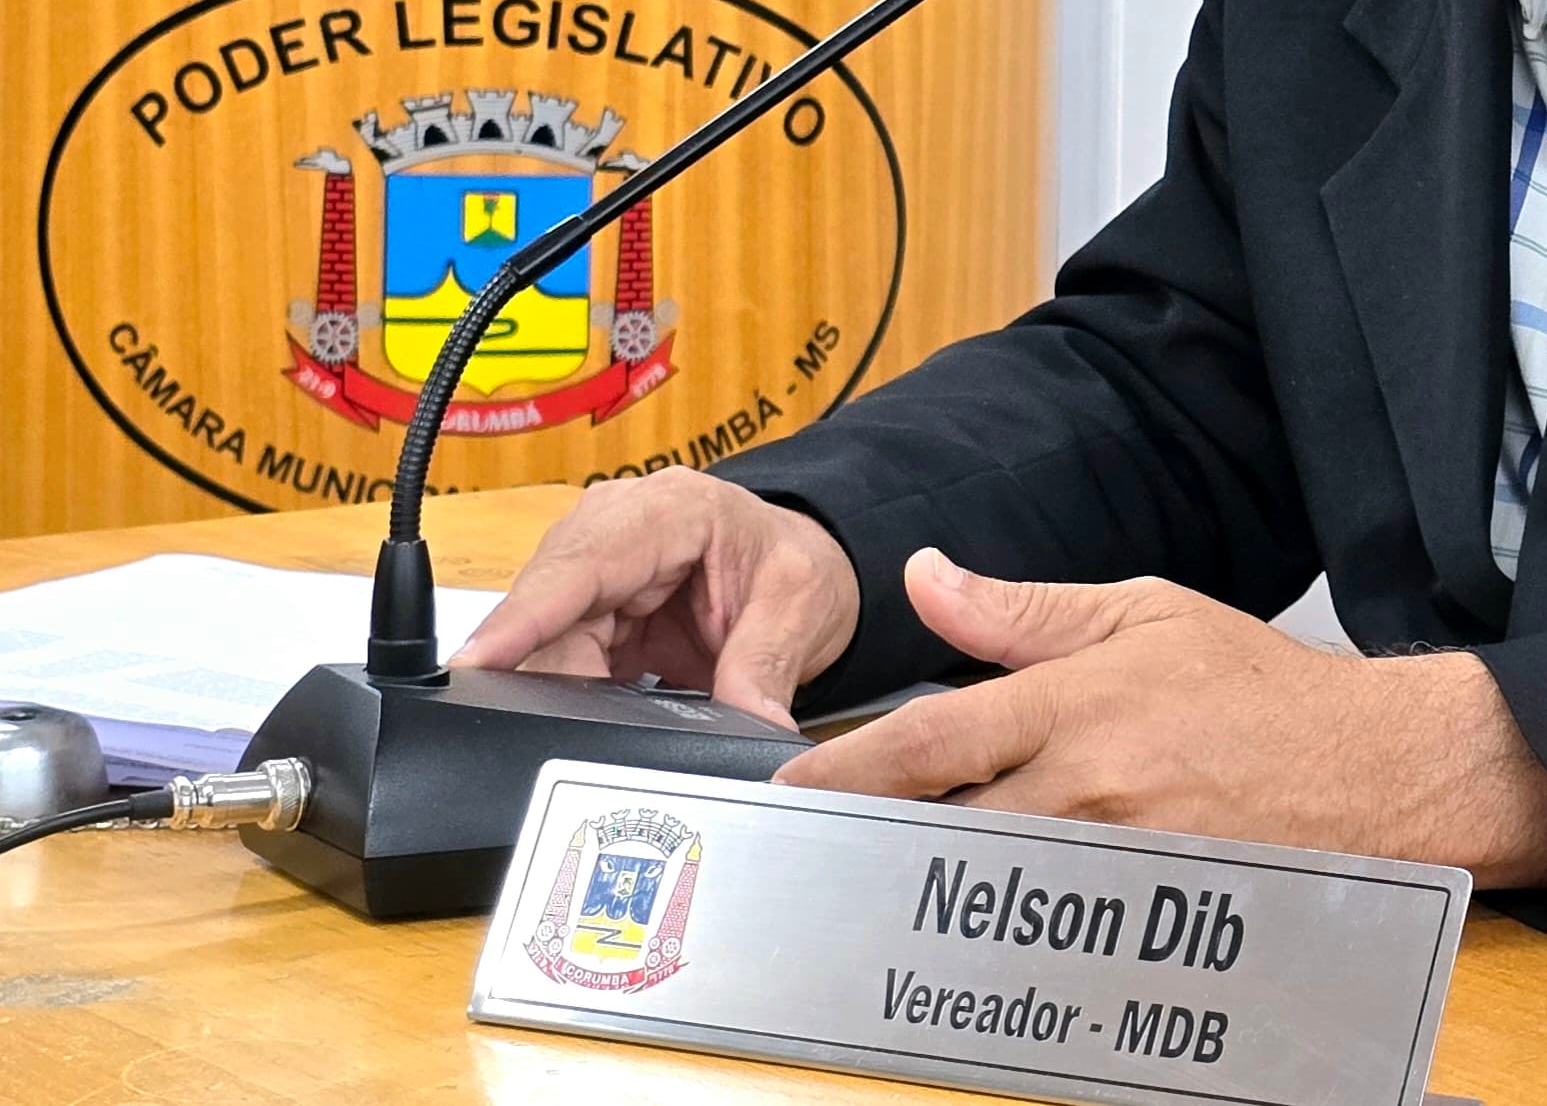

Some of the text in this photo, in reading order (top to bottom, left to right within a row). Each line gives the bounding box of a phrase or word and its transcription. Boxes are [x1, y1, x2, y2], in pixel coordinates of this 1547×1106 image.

[130, 9, 371, 147] PODER
[108, 322, 246, 464] CÂMARA
[793, 320, 840, 381] MS
[441, 399, 543, 433] ORUMBÁ
[912, 856, 1245, 973] Nelson Dib
[883, 967, 1082, 1044] Vereador
[1113, 998, 1229, 1065] MDB
